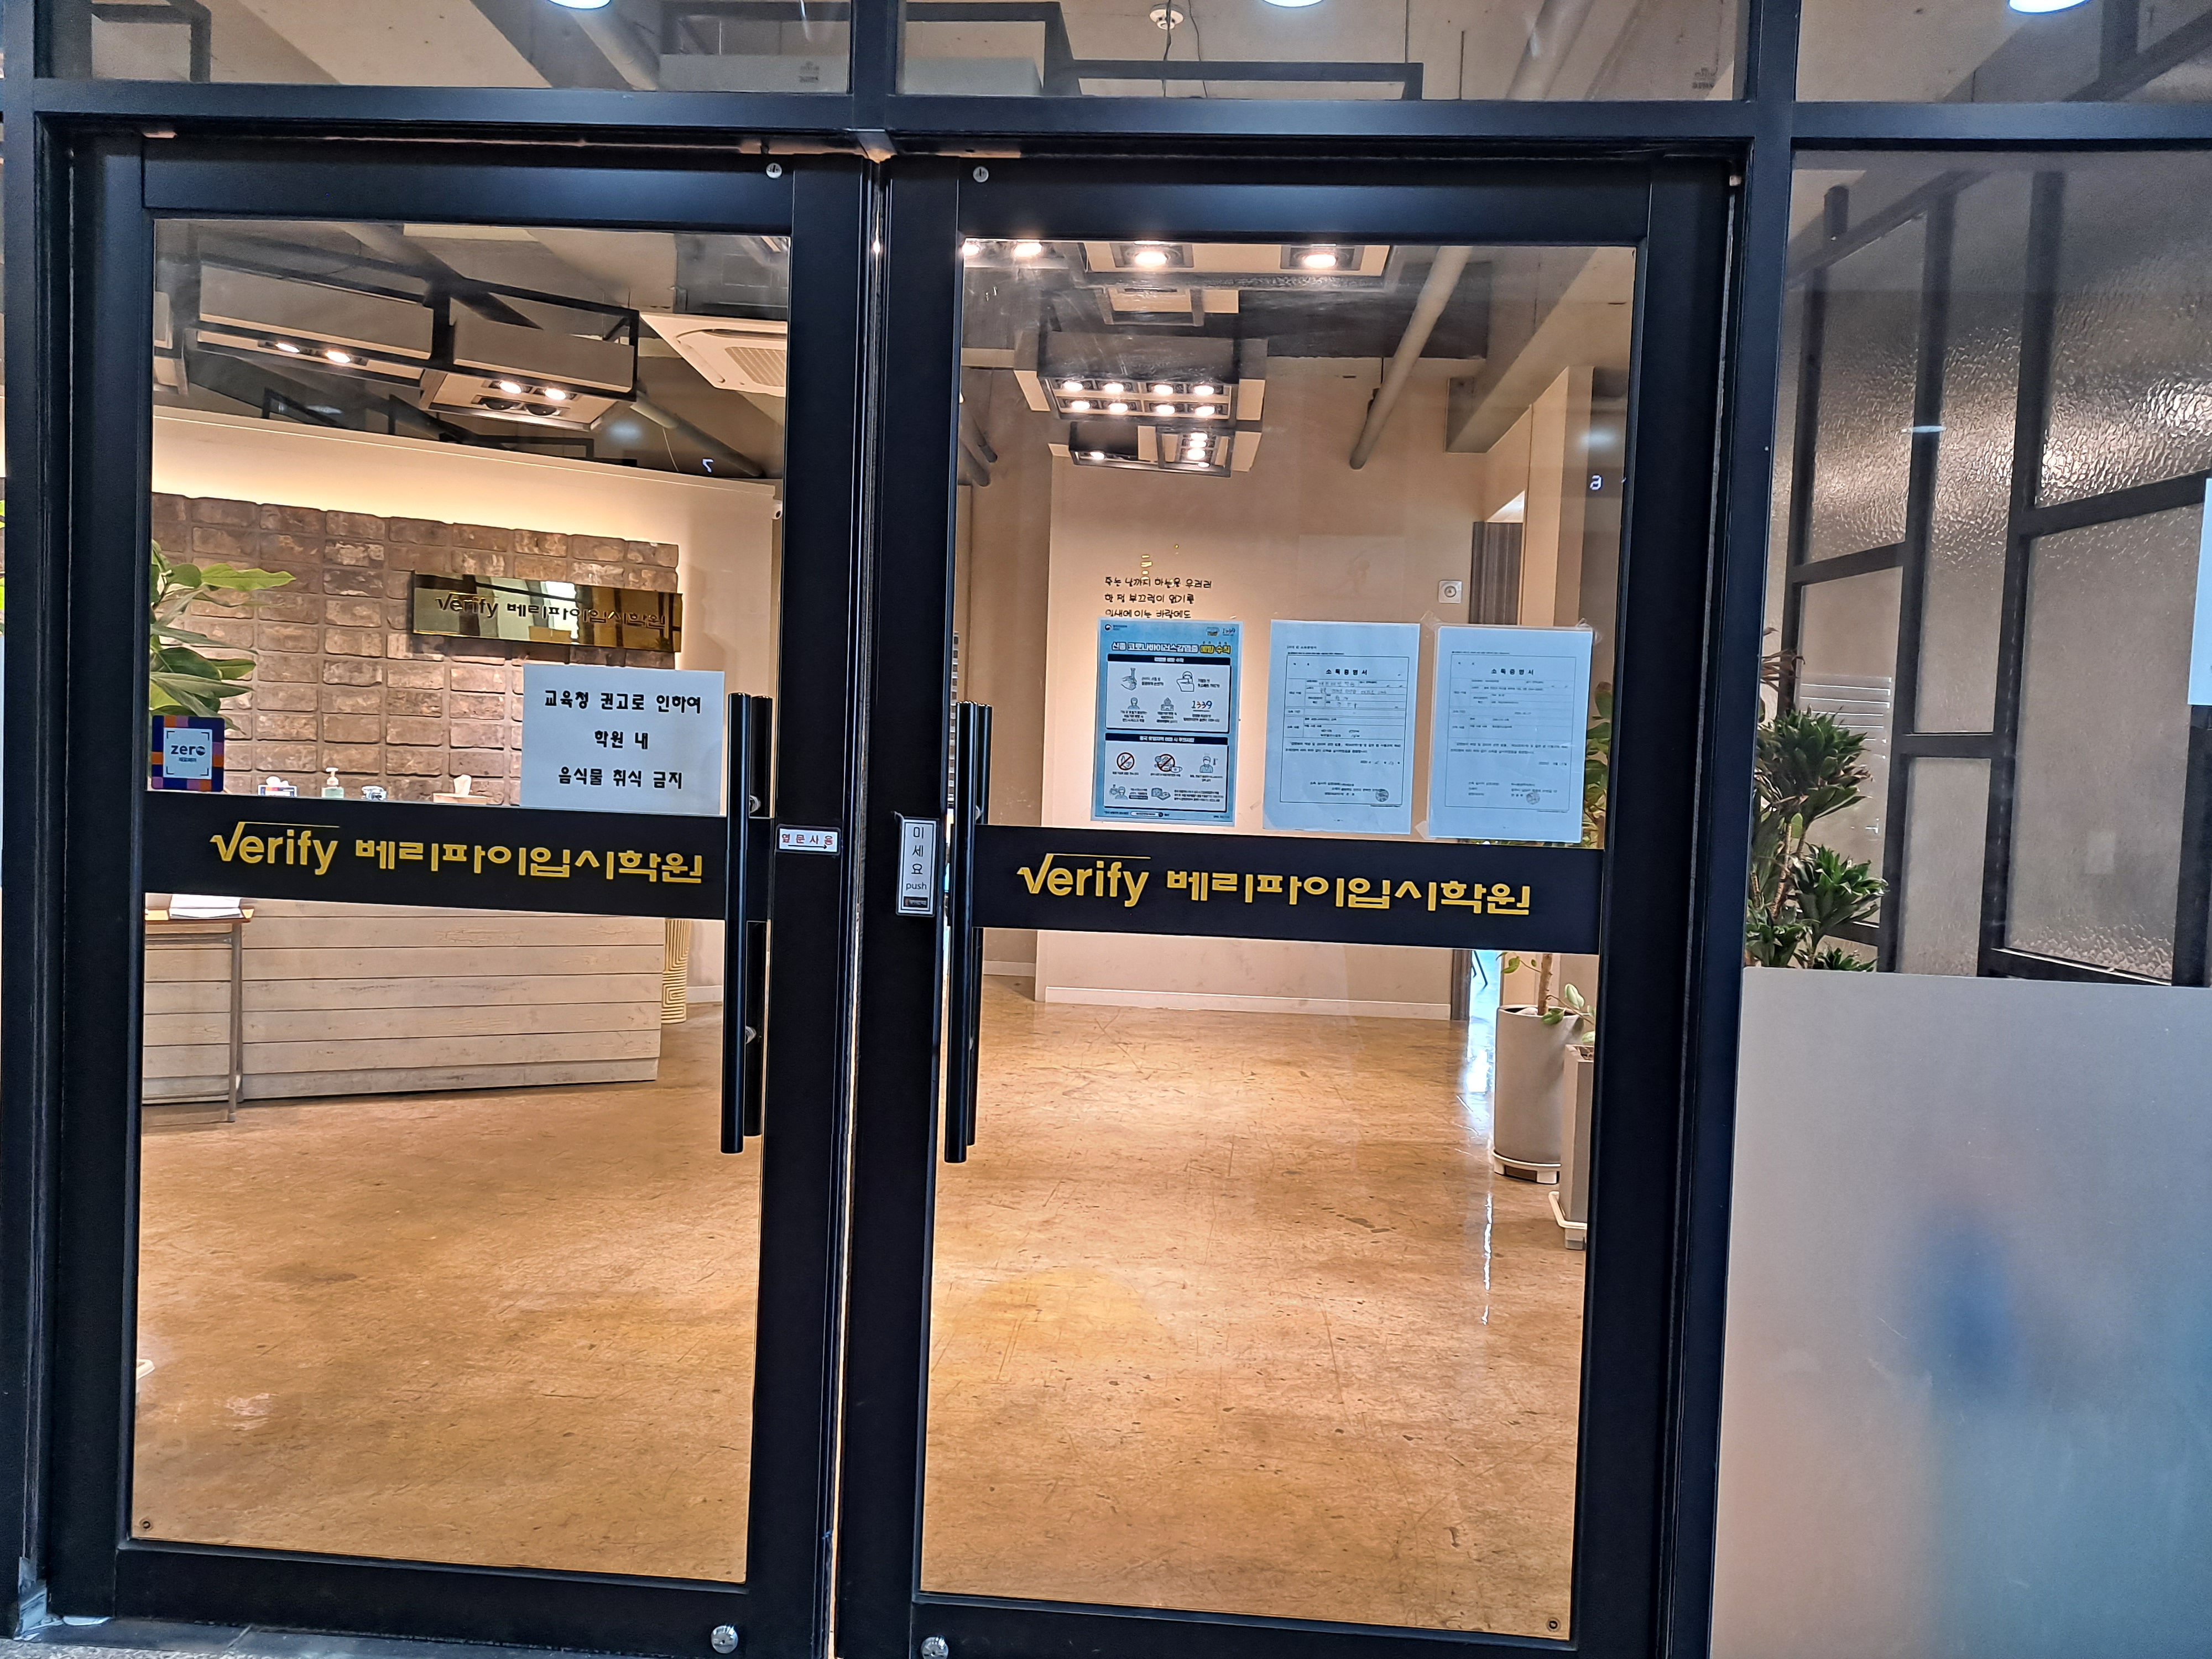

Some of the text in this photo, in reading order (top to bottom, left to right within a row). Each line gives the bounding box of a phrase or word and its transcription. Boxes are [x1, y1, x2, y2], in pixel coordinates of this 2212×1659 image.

[436, 591, 666, 629] Verify 베리파이입시학원
[545, 690, 701, 714] 교육청 권고로 인하여
[1191, 700, 1213, 709] 1339
[171, 745, 206, 756] zero
[594, 730, 648, 750] 학원 내
[559, 766, 682, 790] 음식물 취식 금지
[211, 821, 703, 884] Verify 베리파이입시학원
[910, 826, 924, 875] 미세요
[905, 881, 927, 891] push
[1017, 853, 1530, 916] Verify 베리파이입시학원
